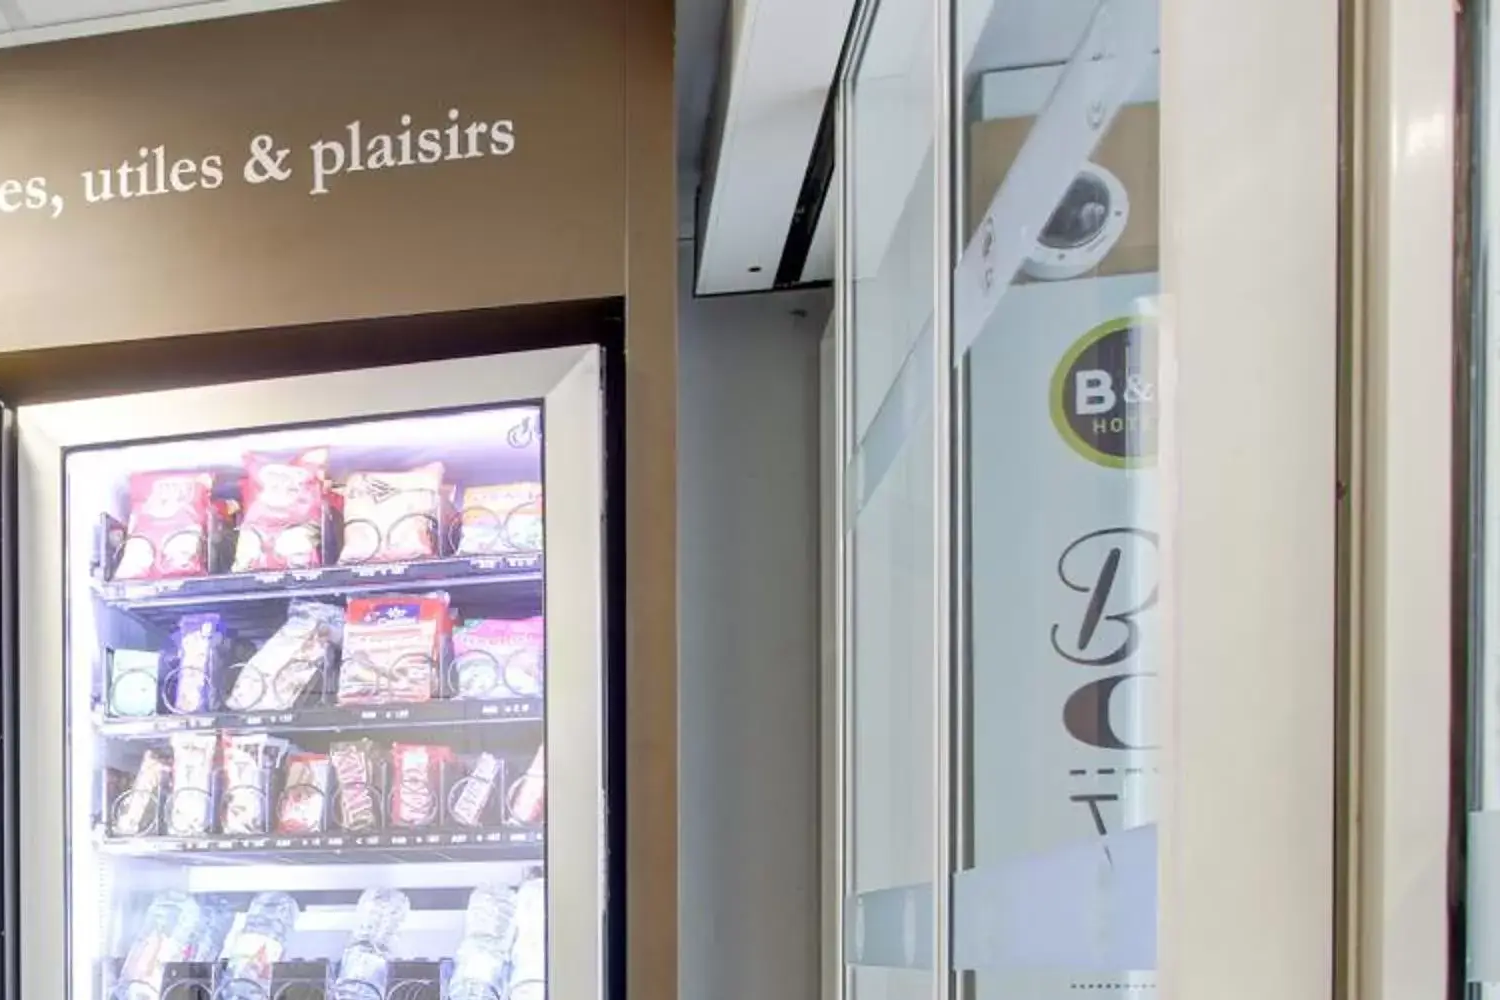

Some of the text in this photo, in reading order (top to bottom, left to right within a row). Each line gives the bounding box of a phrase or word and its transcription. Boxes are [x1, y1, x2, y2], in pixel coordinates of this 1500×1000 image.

[82, 148, 226, 208] utiles
[243, 136, 292, 185] &
[310, 115, 517, 199] plaisirs
